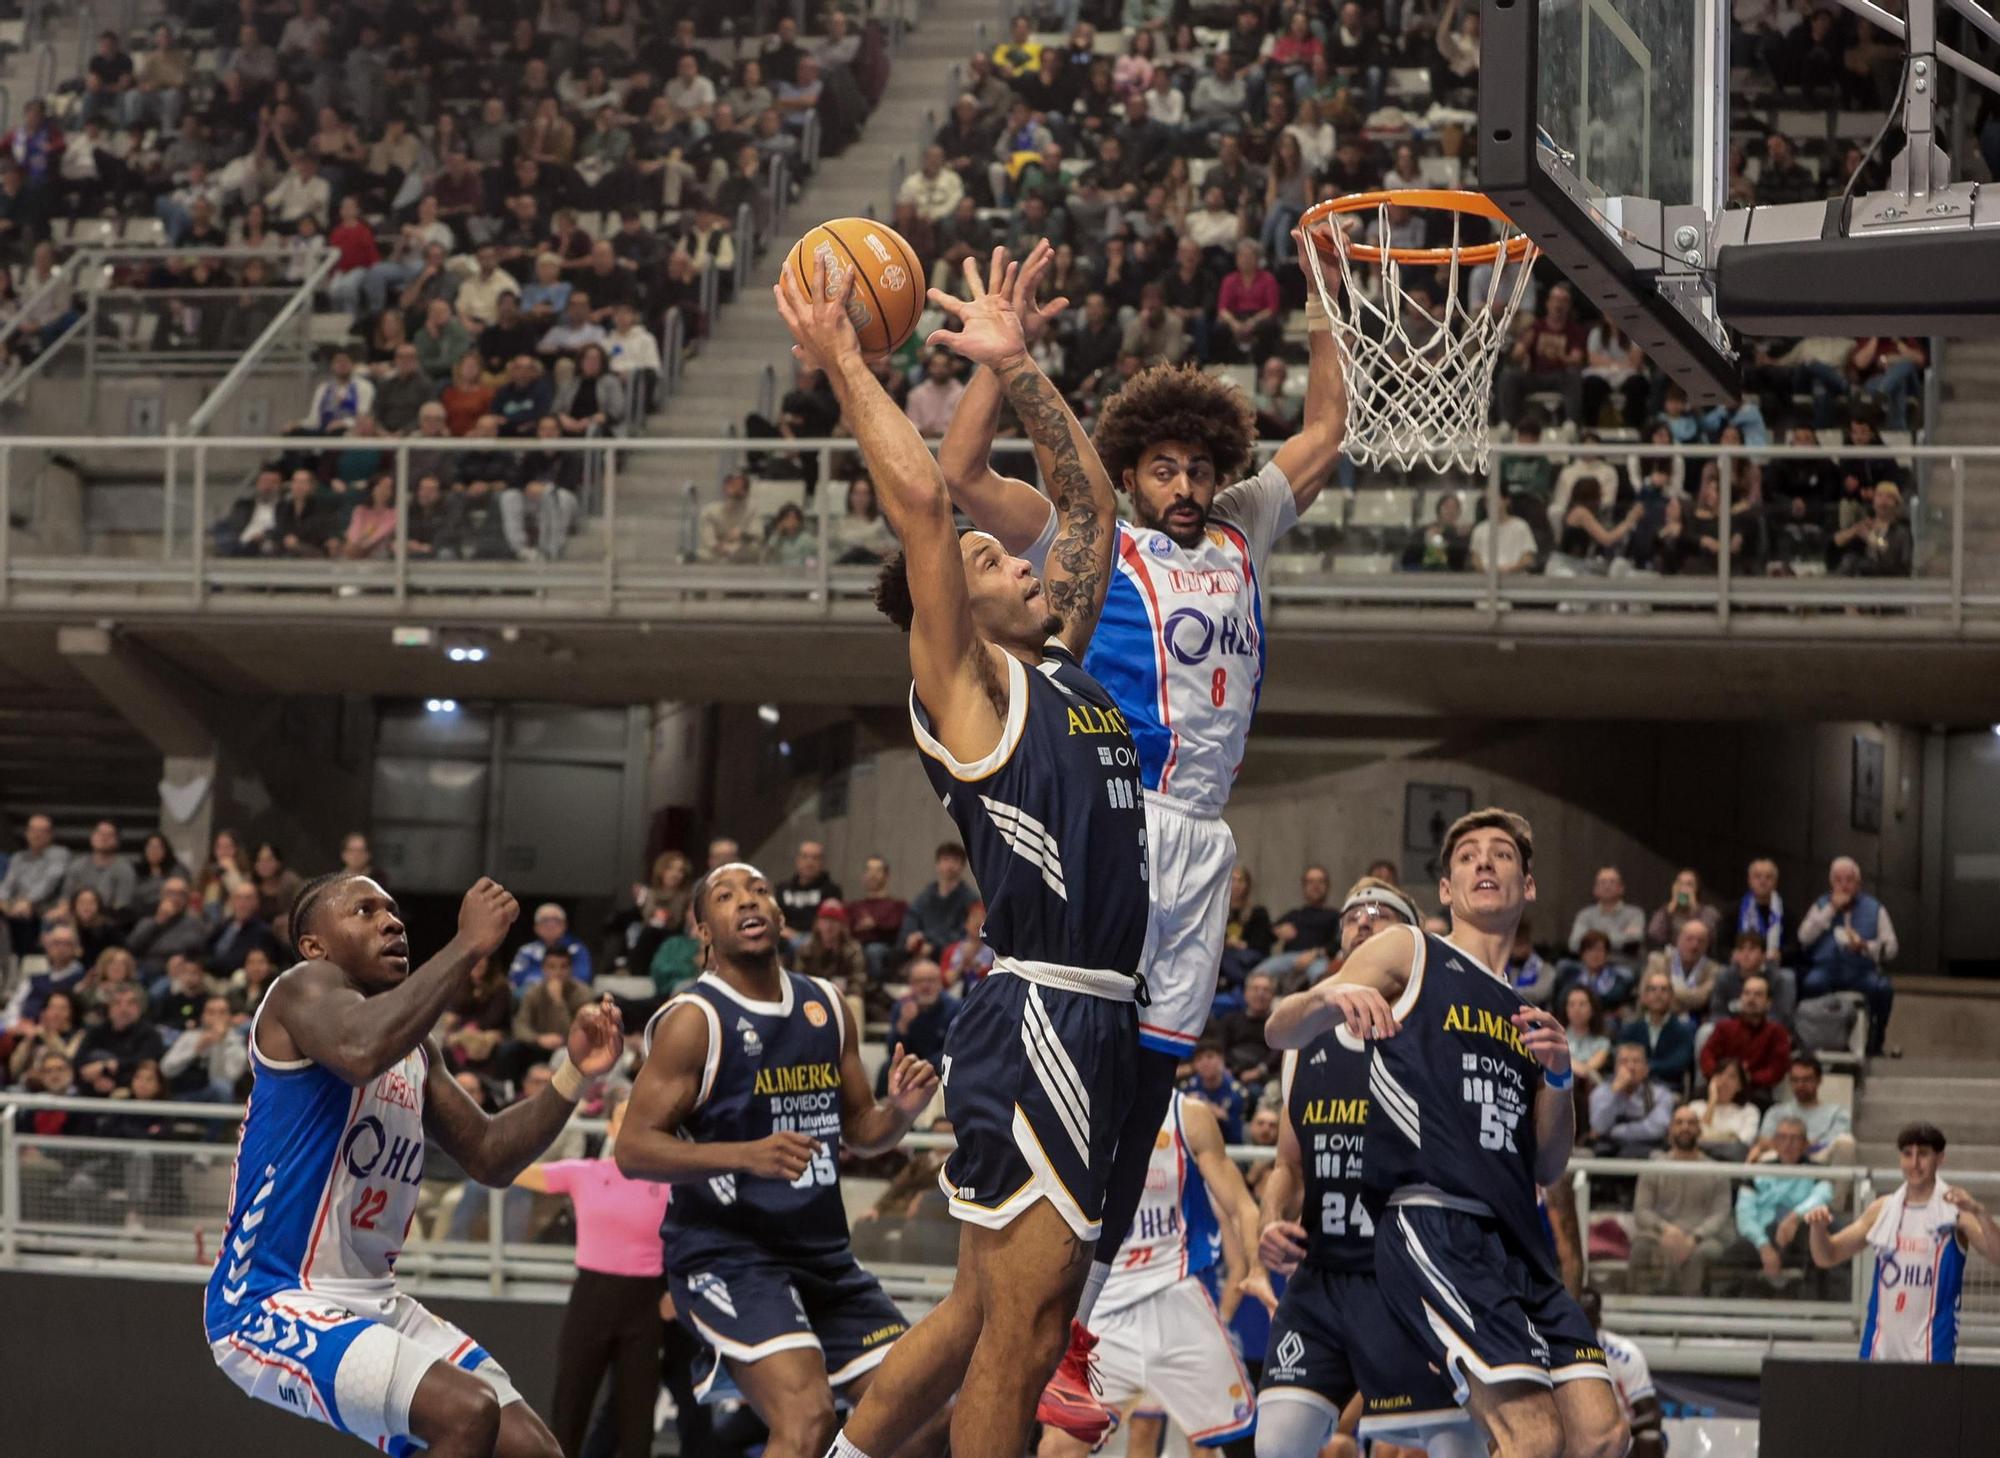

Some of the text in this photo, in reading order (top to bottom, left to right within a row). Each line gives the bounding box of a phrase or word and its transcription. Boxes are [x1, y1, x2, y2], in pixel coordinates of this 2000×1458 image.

[1210, 667, 1227, 708] 8
[753, 1062, 841, 1095] ALIMERKA
[783, 1092, 831, 1113] OVIEDO
[350, 1185, 388, 1231] 22
[1126, 1206, 1181, 1240] HLA
[1321, 1191, 1375, 1237] 24
